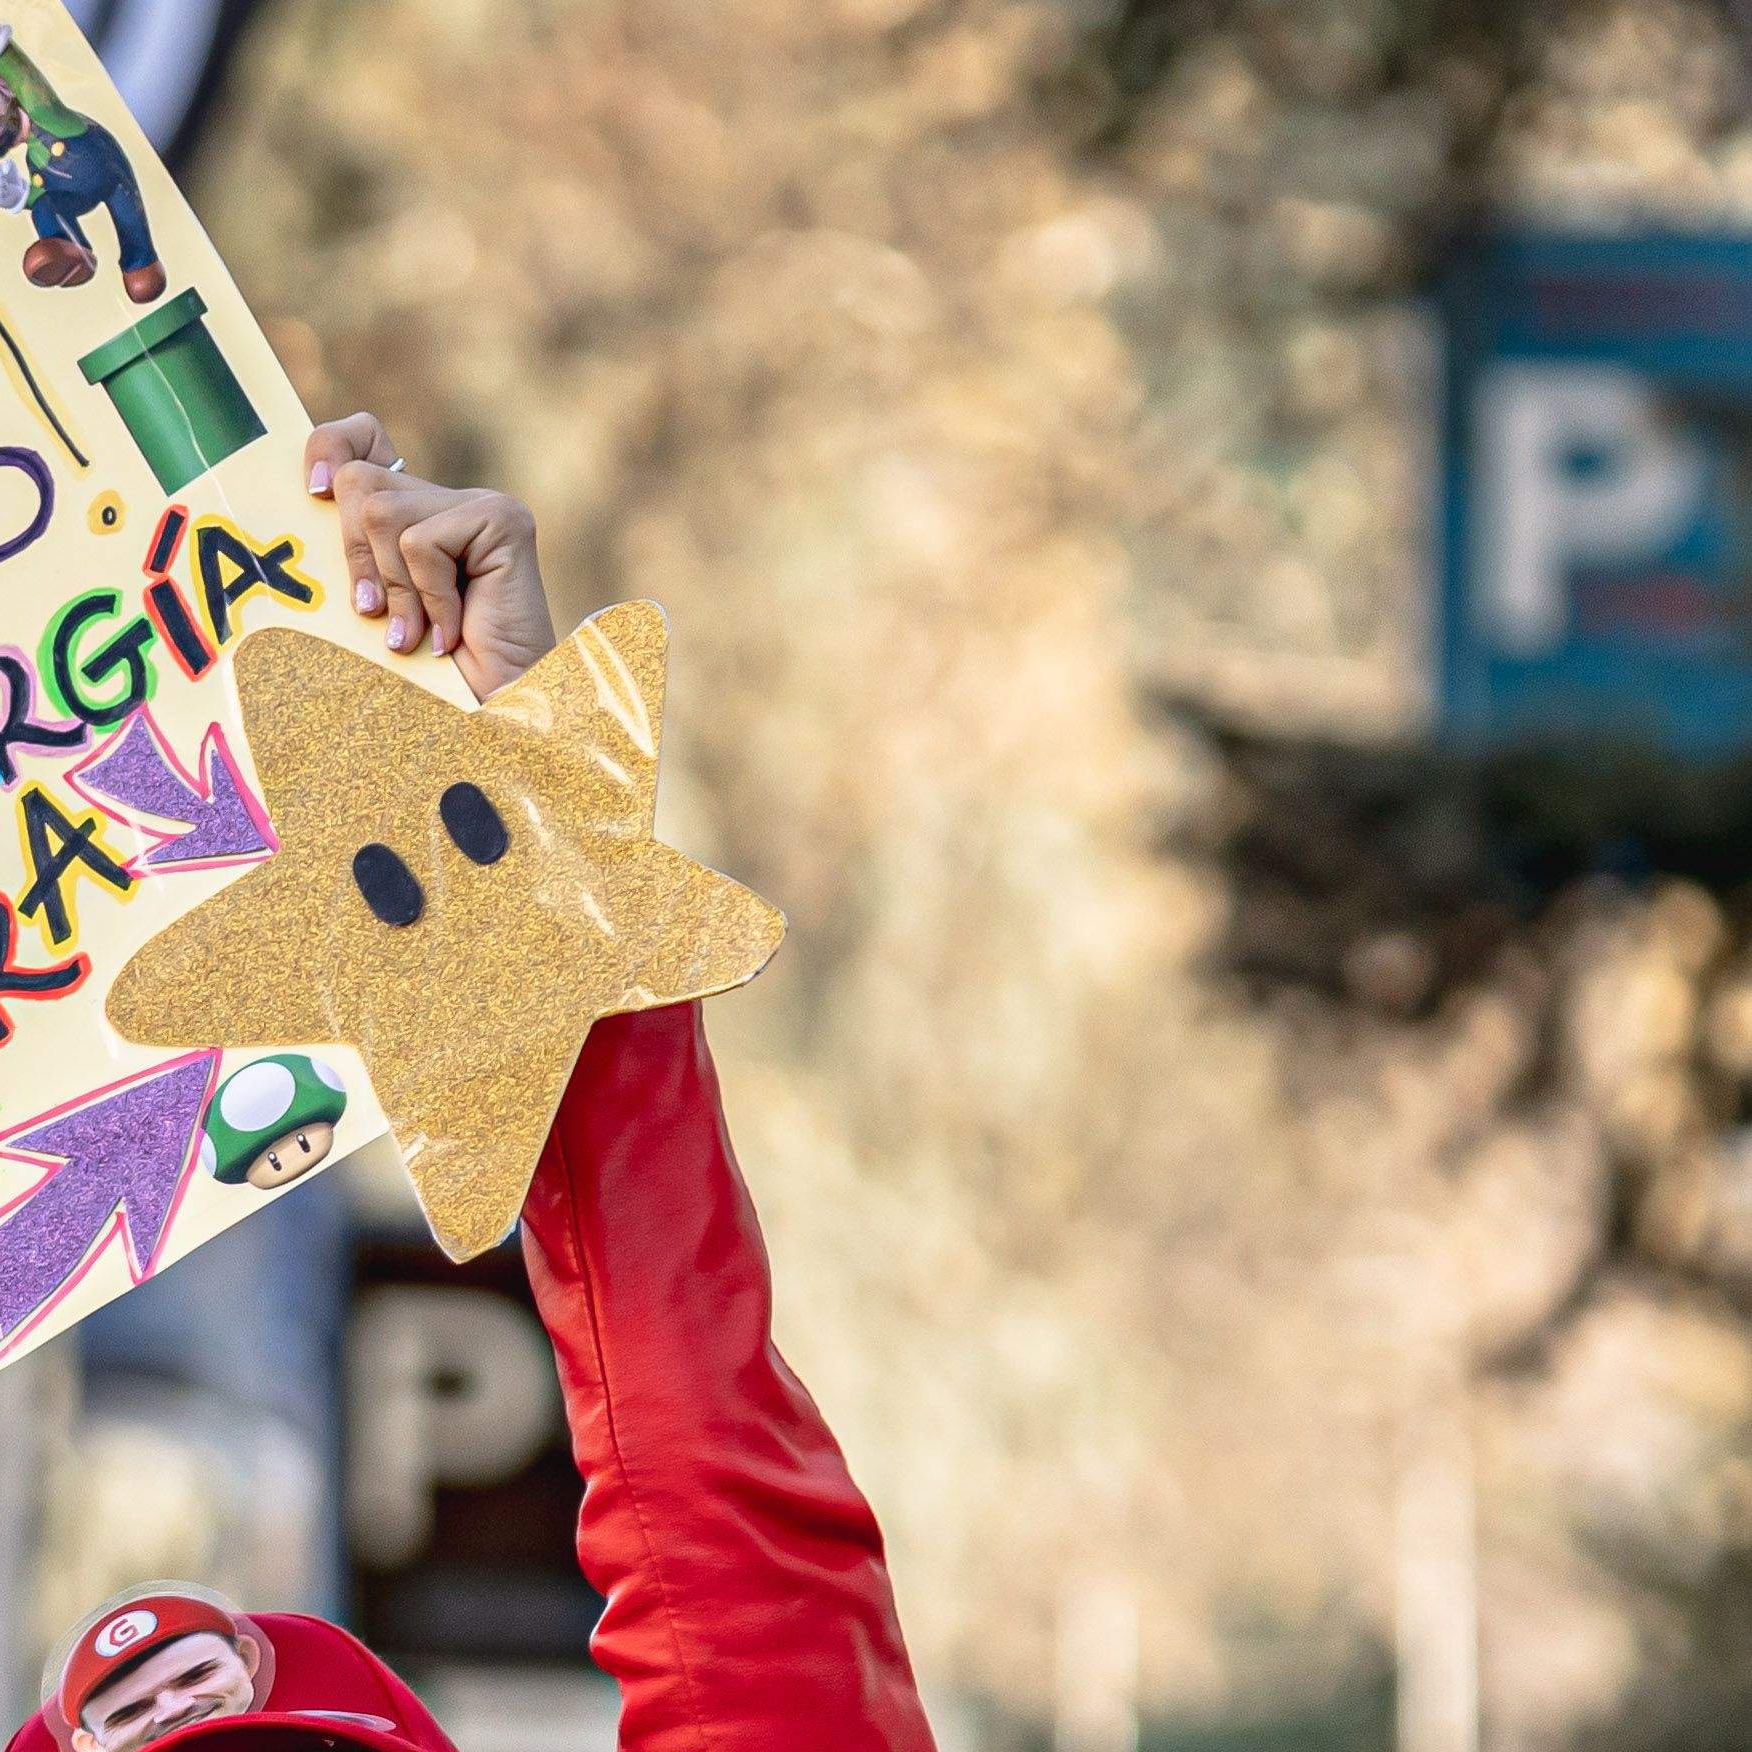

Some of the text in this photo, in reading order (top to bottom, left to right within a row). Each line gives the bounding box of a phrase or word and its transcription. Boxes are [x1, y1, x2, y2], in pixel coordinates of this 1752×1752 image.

[1472, 358, 1707, 658] P
[347, 1282, 559, 1574] P
[109, 1617, 139, 1647] G
